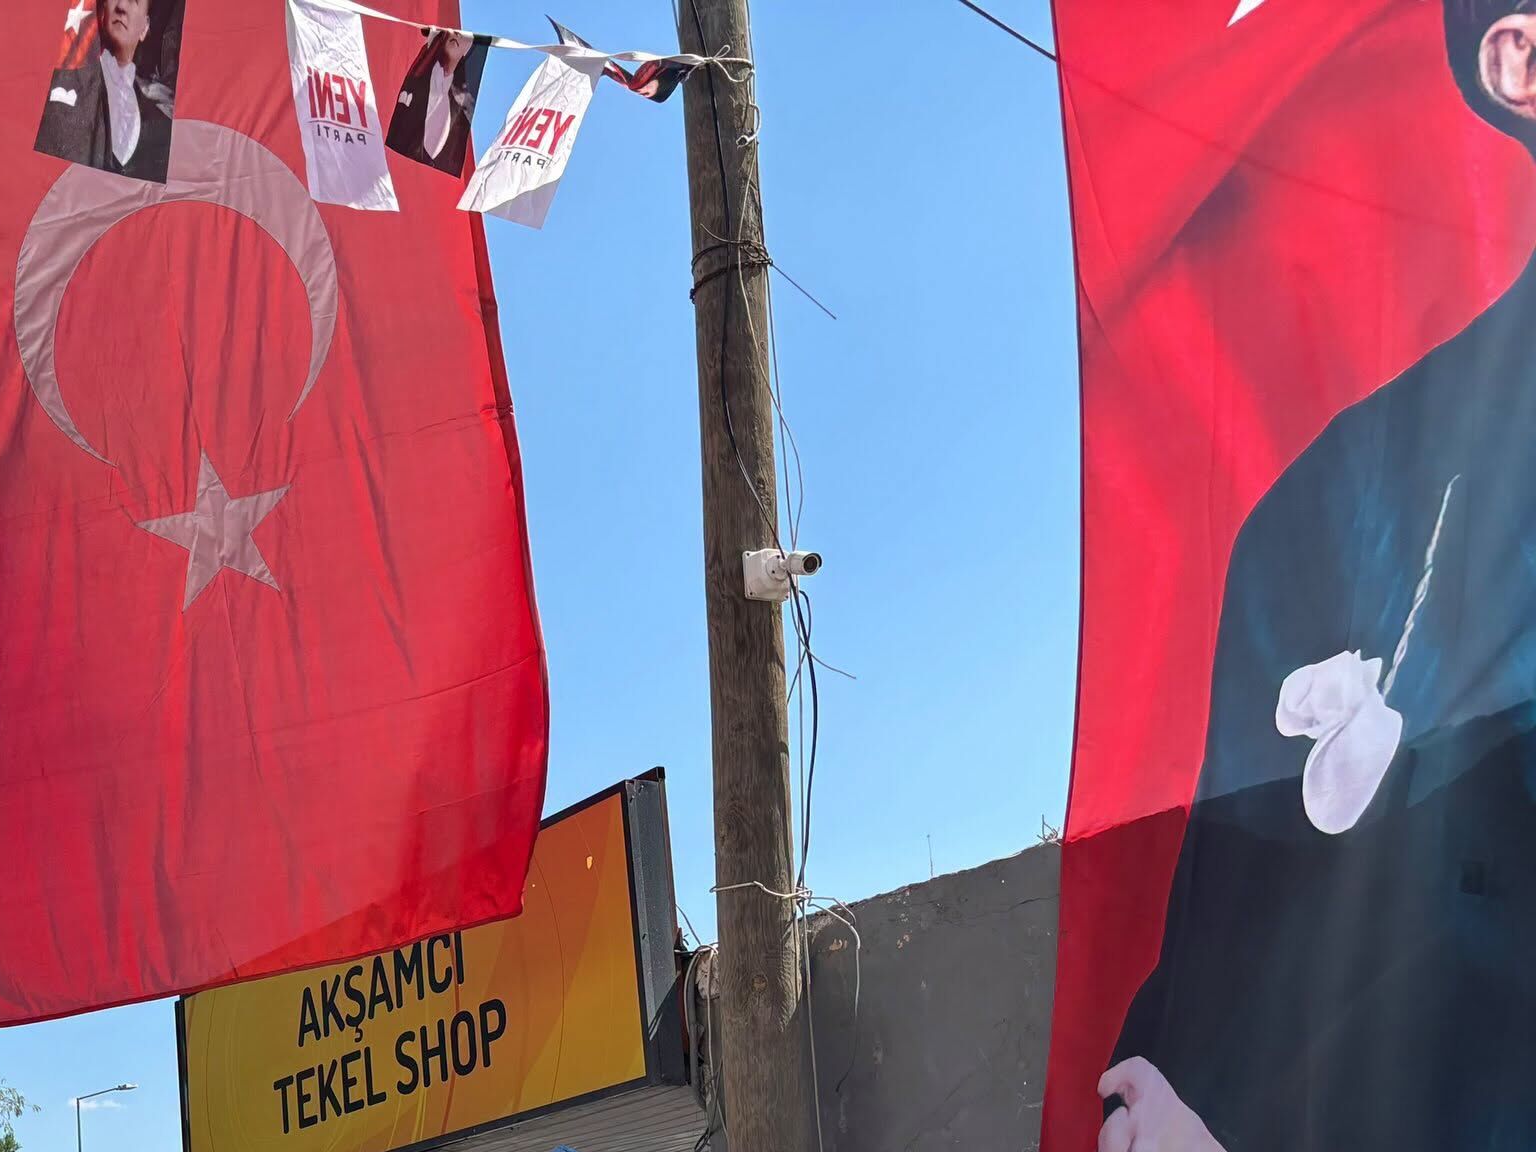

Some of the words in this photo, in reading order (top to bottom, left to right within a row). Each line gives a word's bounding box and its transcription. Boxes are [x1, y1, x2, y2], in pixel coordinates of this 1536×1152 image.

[297, 929, 465, 1043] AKŞAMCI
[273, 1045, 387, 1134] TEKEL
[395, 997, 508, 1096] SHOP
